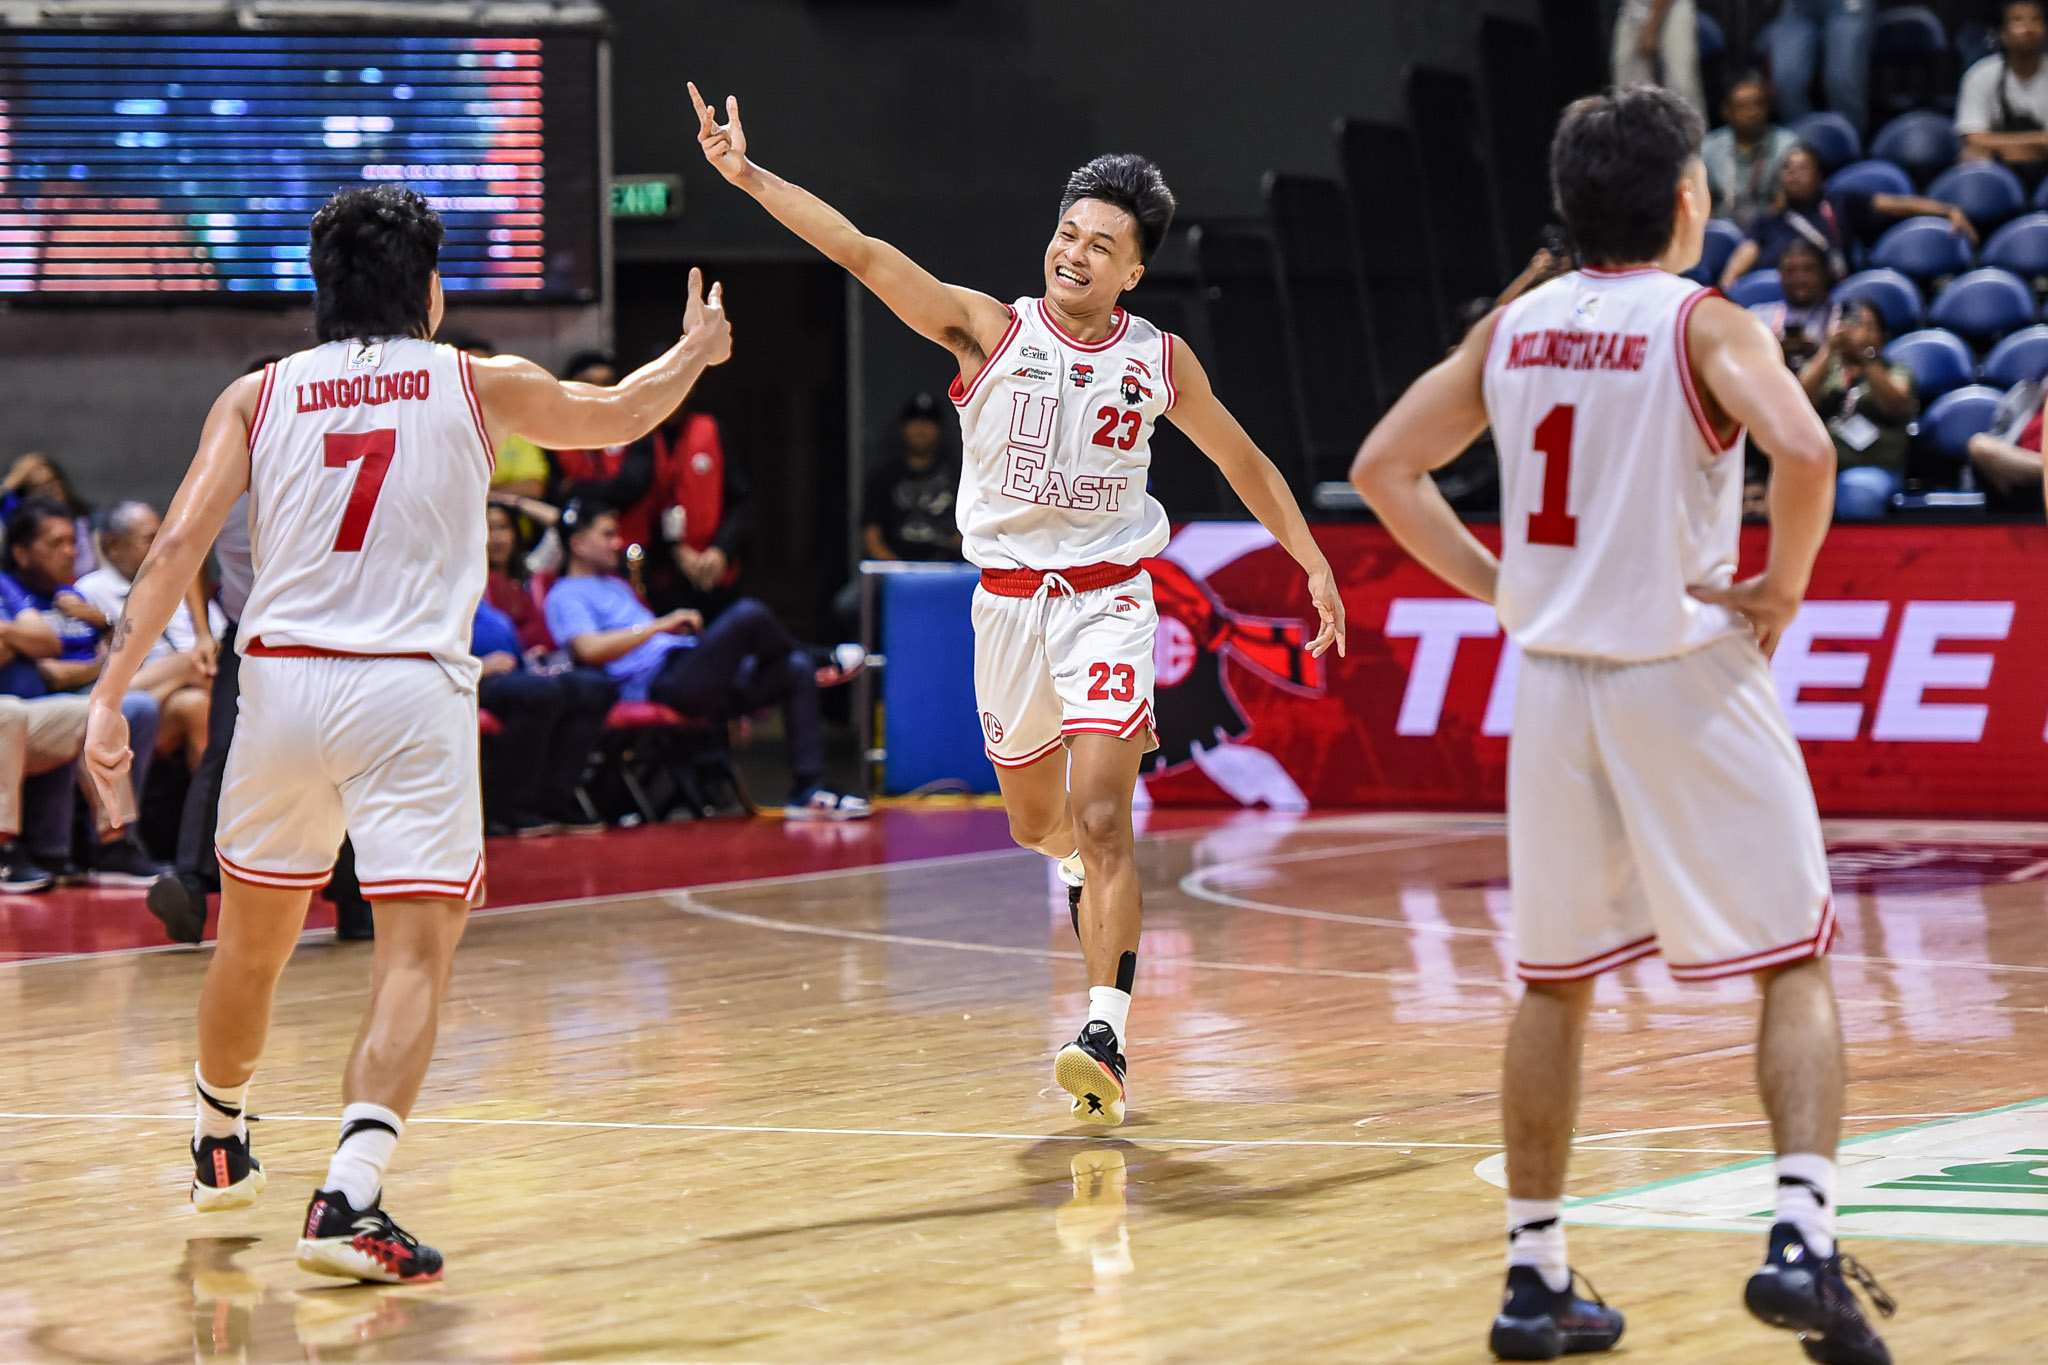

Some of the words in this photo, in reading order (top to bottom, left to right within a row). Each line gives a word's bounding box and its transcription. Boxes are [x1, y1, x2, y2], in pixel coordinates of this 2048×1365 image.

[296, 369, 430, 413] LINGOLINGO
[1027, 367, 1053, 376] Philippine
[1027, 373, 1046, 381] Airlines
[1125, 364, 1142, 375] ANTA
[1009, 391, 1058, 449] U
[1092, 405, 1143, 451] 23
[323, 428, 396, 552] 7
[1001, 445, 1128, 512] EAST
[1526, 402, 1578, 547] 1
[1115, 603, 1132, 613] ANTA
[1087, 661, 1135, 703] 23
[1384, 597, 2016, 743] TEE
